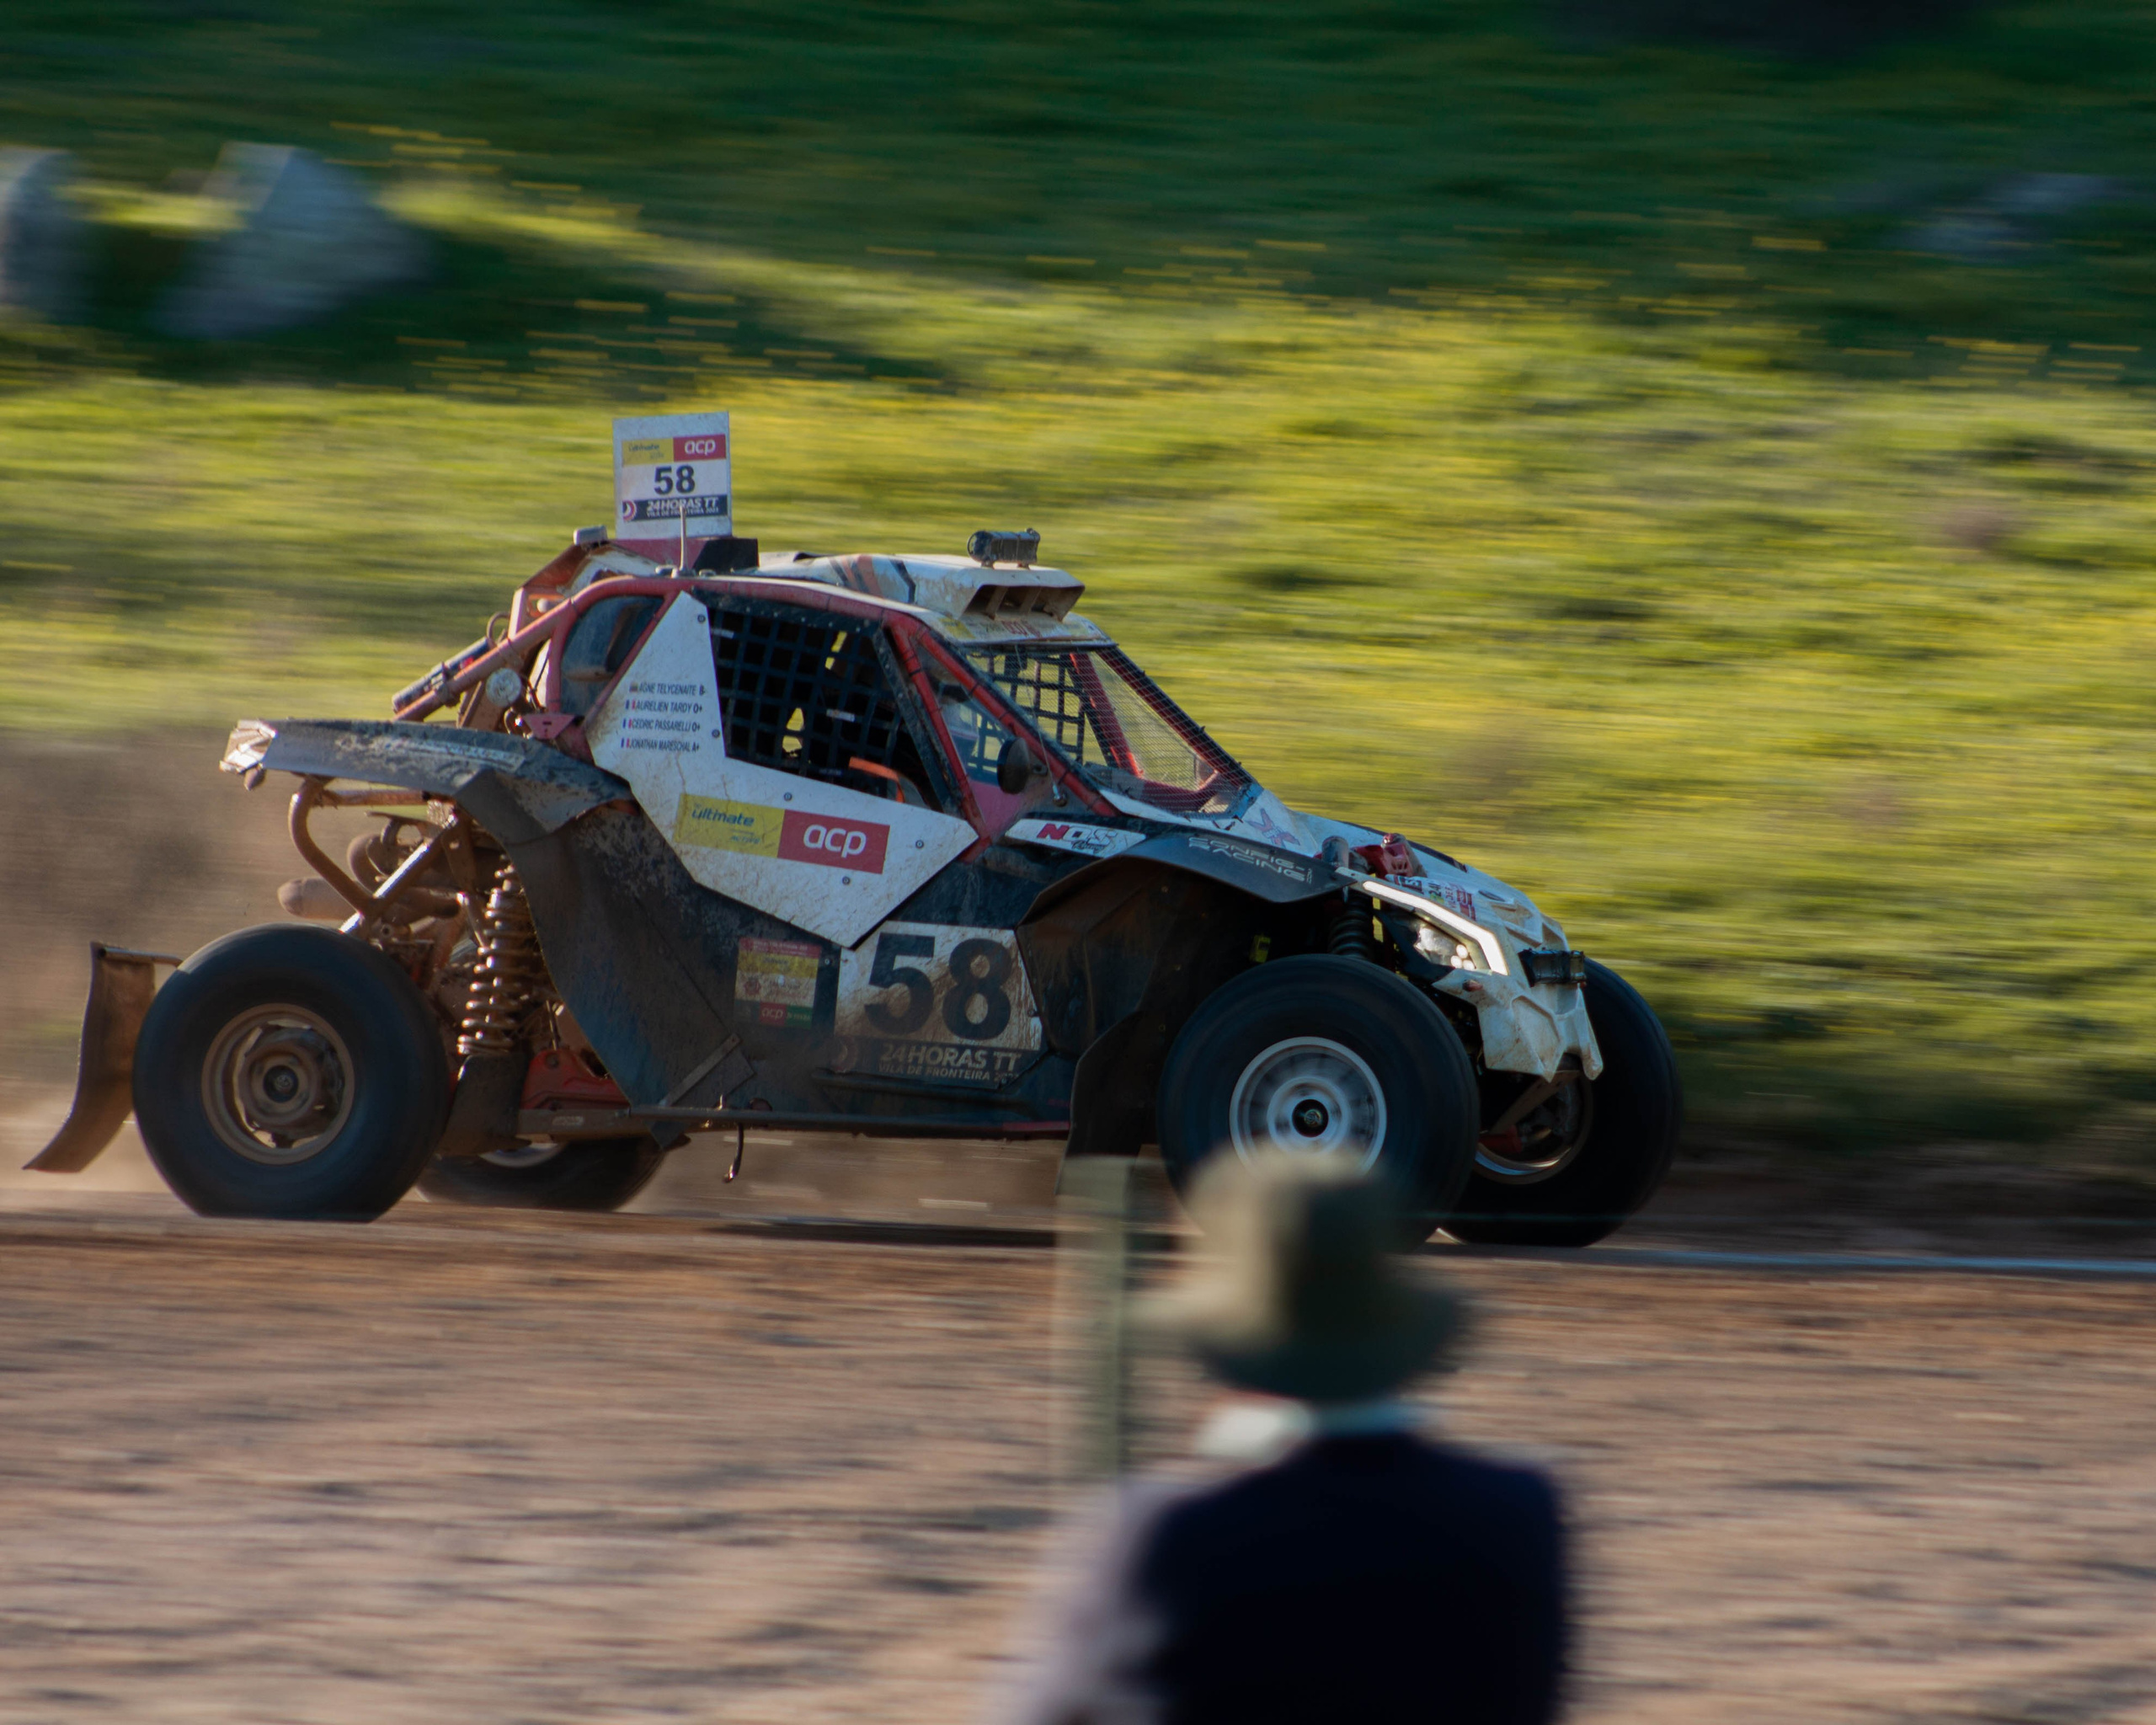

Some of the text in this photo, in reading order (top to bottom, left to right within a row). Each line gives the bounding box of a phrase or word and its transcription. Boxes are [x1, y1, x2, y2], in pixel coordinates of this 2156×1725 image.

[684, 439, 716, 456] acp
[654, 464, 696, 495] 58
[703, 496, 719, 506] TT
[639, 681, 655, 693] AGNE
[635, 700, 668, 713] AURELIEN
[670, 702, 692, 713] TARDY
[632, 718, 654, 730] CEDRIC
[629, 737, 657, 750] JONATHAN
[691, 808, 755, 827] ultimate
[803, 824, 867, 858] acp
[1036, 823, 1118, 846] NOS
[863, 932, 1011, 1040] 58
[878, 1060, 905, 1075] VILA
[906, 1064, 922, 1076] DE
[926, 1065, 990, 1081] FRONTEIRA
[993, 1050, 1022, 1072] TT
